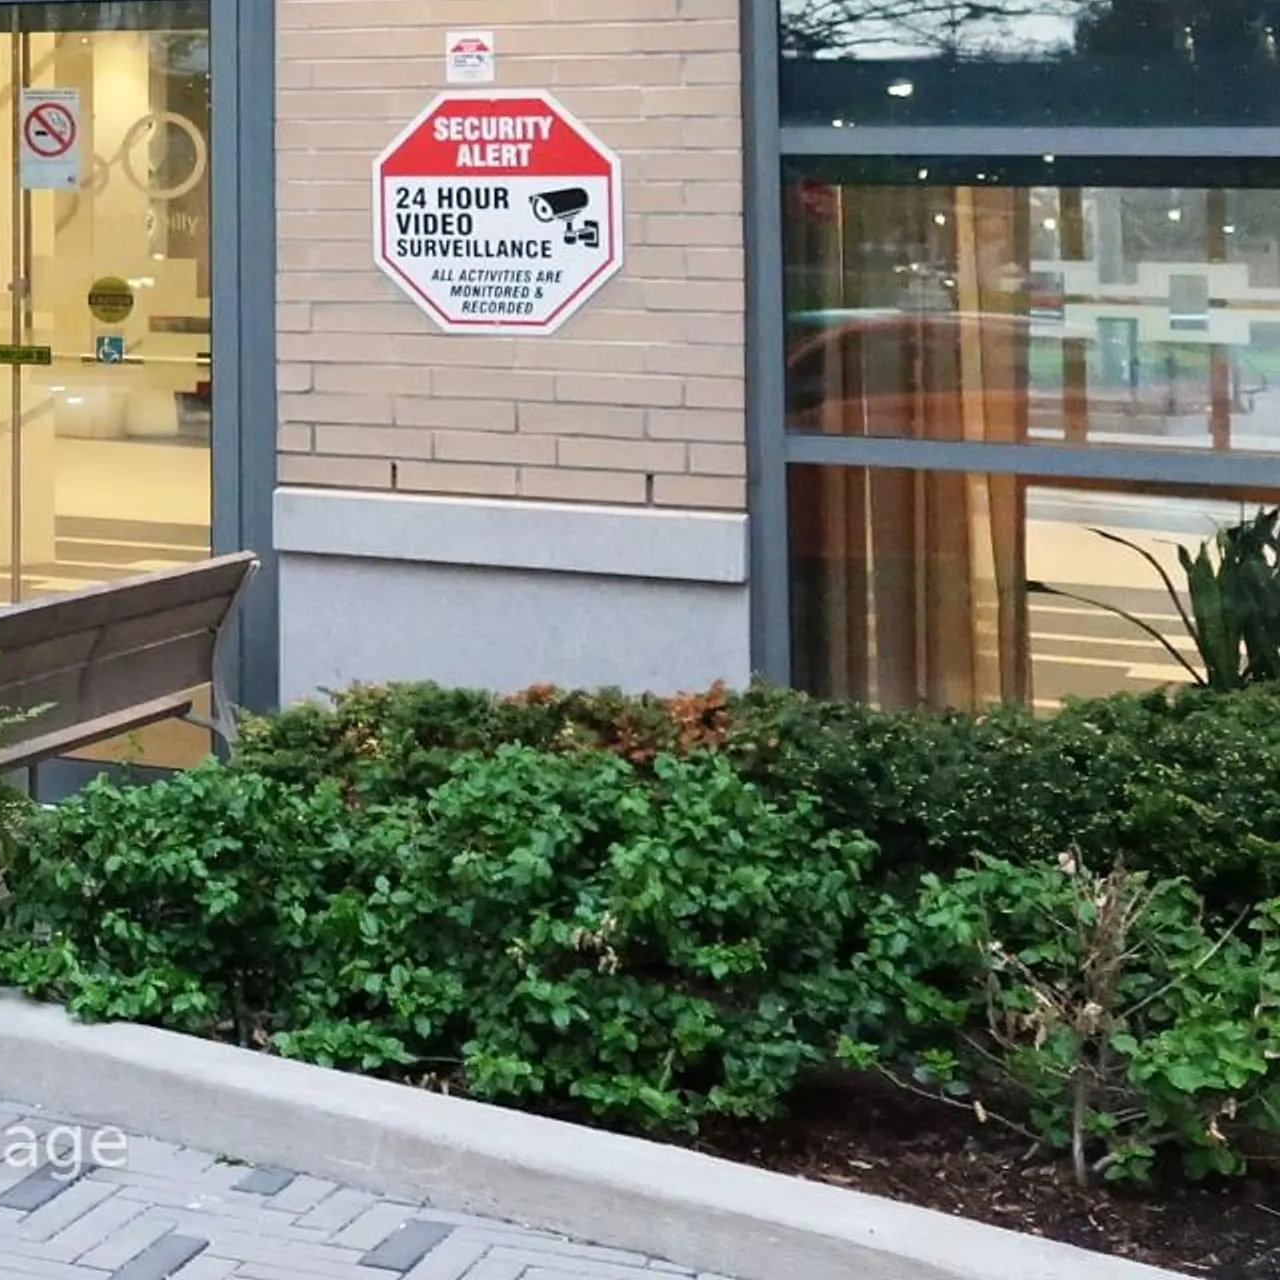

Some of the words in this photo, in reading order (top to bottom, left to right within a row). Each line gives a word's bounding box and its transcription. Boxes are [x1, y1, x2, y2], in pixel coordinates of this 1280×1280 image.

[432, 115, 553, 142] SECURITY
[456, 143, 533, 167] ALERT
[395, 187, 427, 210] 24
[437, 187, 510, 210] HOUR
[396, 213, 473, 236] VIDEO
[396, 238, 552, 259] SURVEILLANCE
[431, 269, 455, 283] ALL
[458, 269, 532, 283] ACTIVITIES
[535, 269, 564, 283] ARE
[450, 285, 529, 299] MONITORED
[534, 285, 544, 299] &
[461, 301, 534, 315] RECORDED
